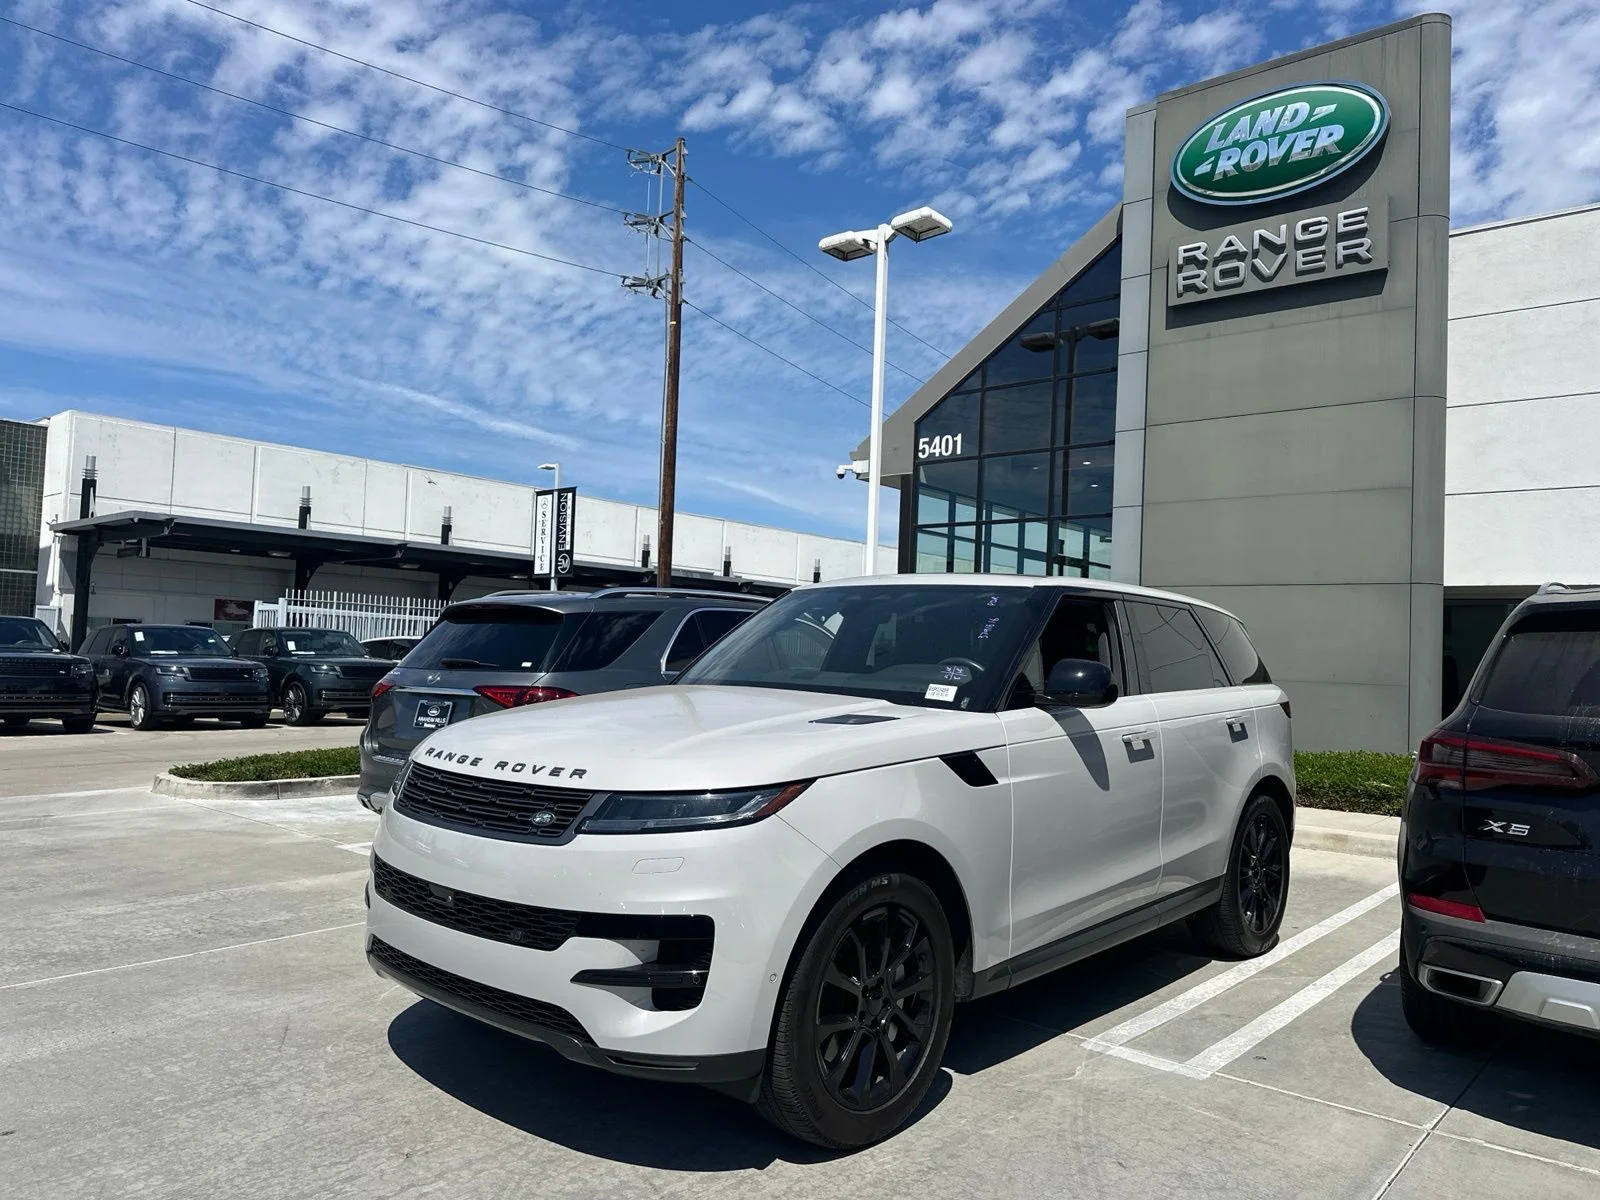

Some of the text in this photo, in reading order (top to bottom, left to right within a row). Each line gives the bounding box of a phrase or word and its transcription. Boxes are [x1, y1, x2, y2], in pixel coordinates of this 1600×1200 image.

[1204, 101, 1310, 153] LAND
[1213, 124, 1344, 181] ROVER
[1177, 207, 1369, 266] RANGE
[1177, 237, 1374, 297] ROVER
[918, 433, 963, 459] 5401
[539, 511, 548, 571] SERVICE
[558, 493, 568, 551] ENVISION
[425, 747, 588, 779] RANGE ROVER
[1478, 819, 1531, 836] X5
